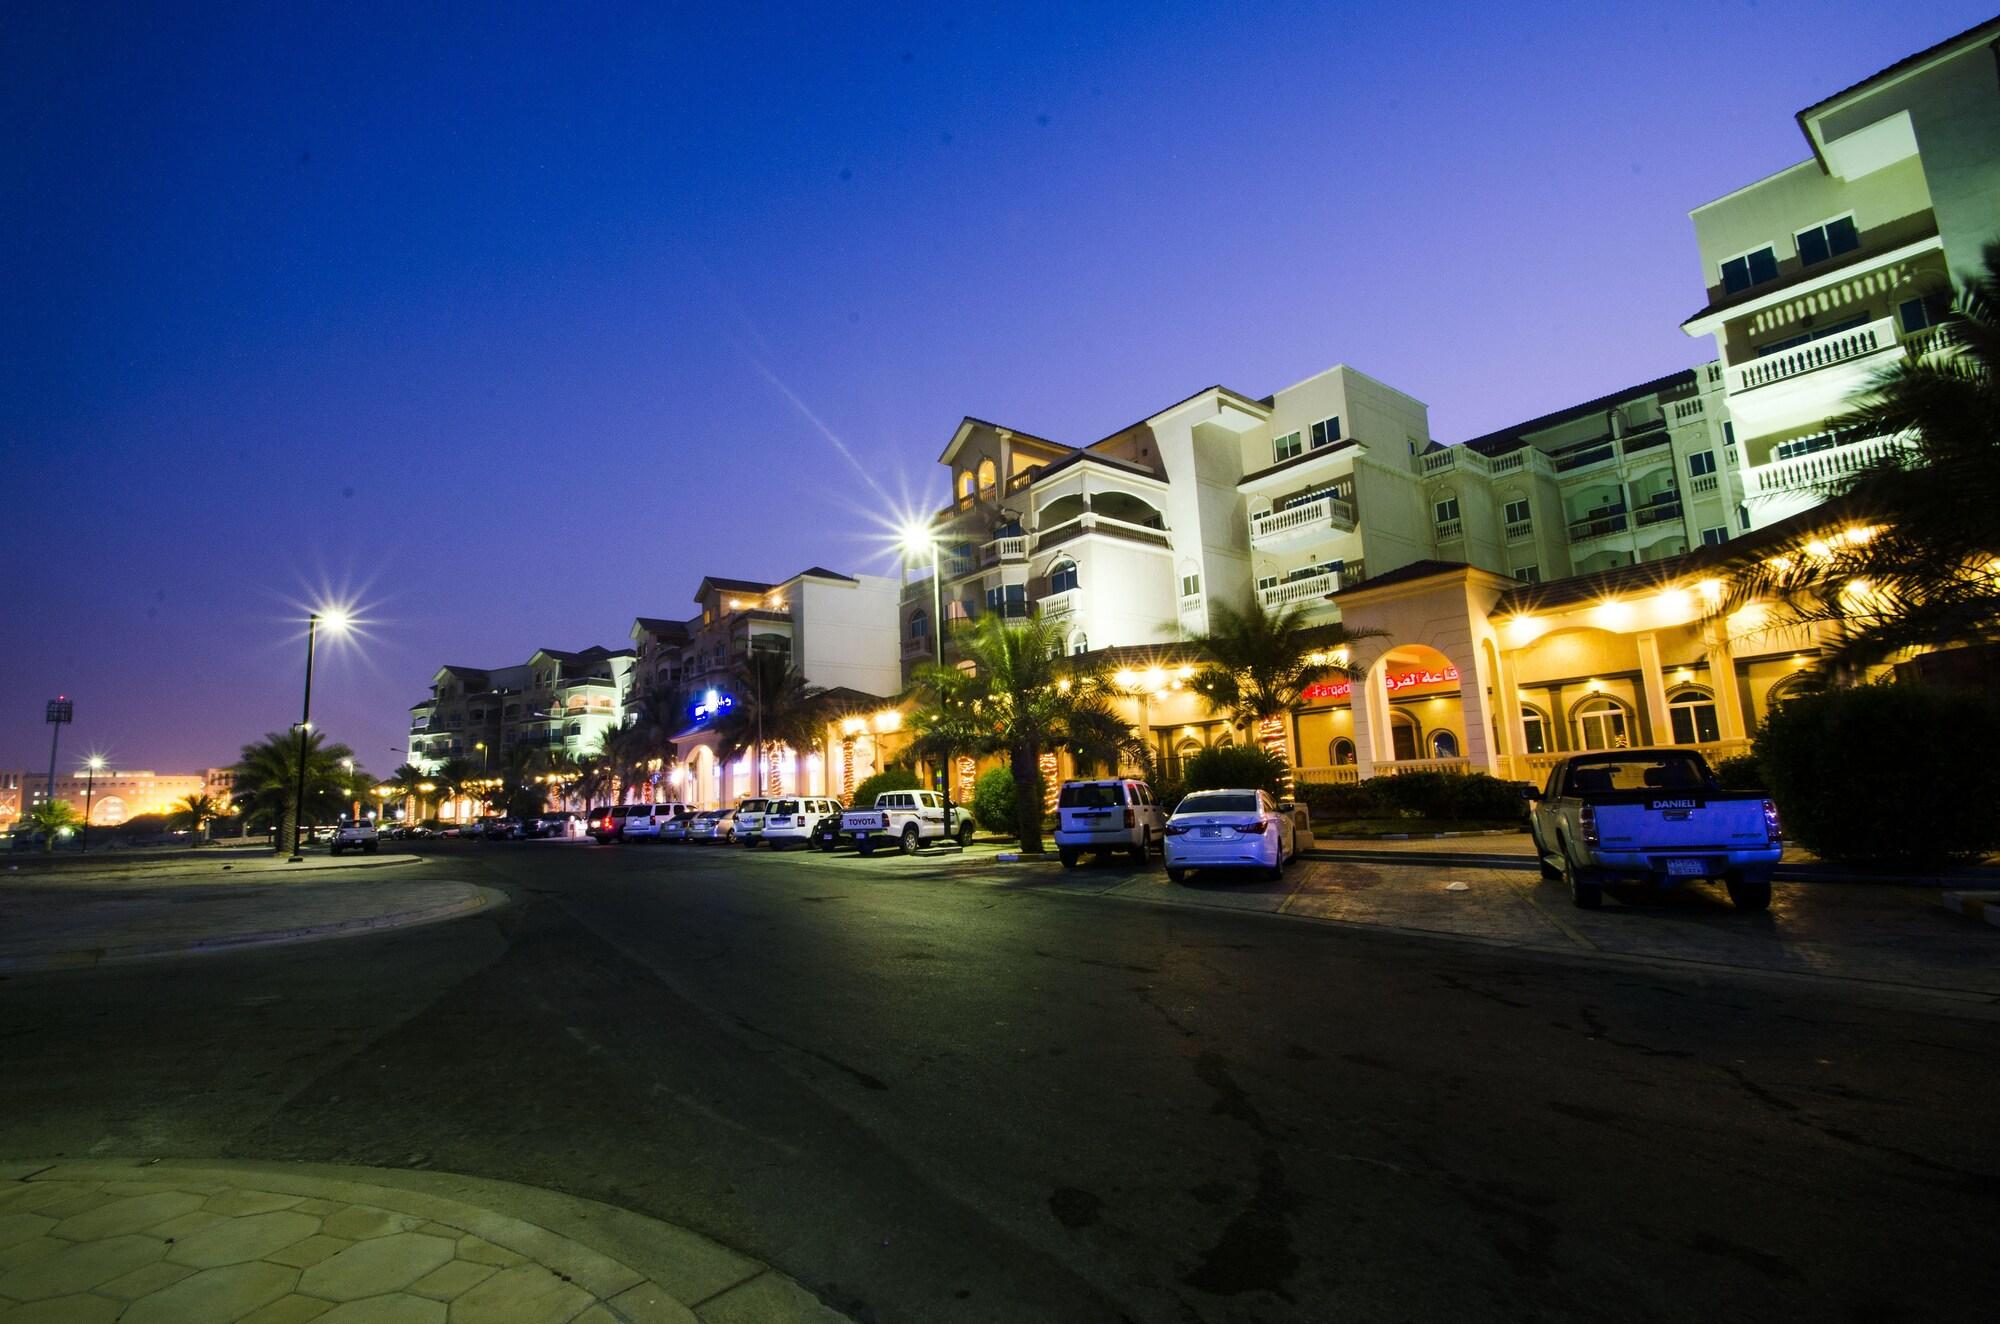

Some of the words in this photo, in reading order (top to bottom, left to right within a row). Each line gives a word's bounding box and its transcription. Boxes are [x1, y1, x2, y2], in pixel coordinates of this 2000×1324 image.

[1421, 666, 1459, 683] قاعة
[1385, 672, 1421, 691] الفرق
[1653, 799, 1696, 809] DANIELI
[849, 817, 877, 826] TOYOTA
